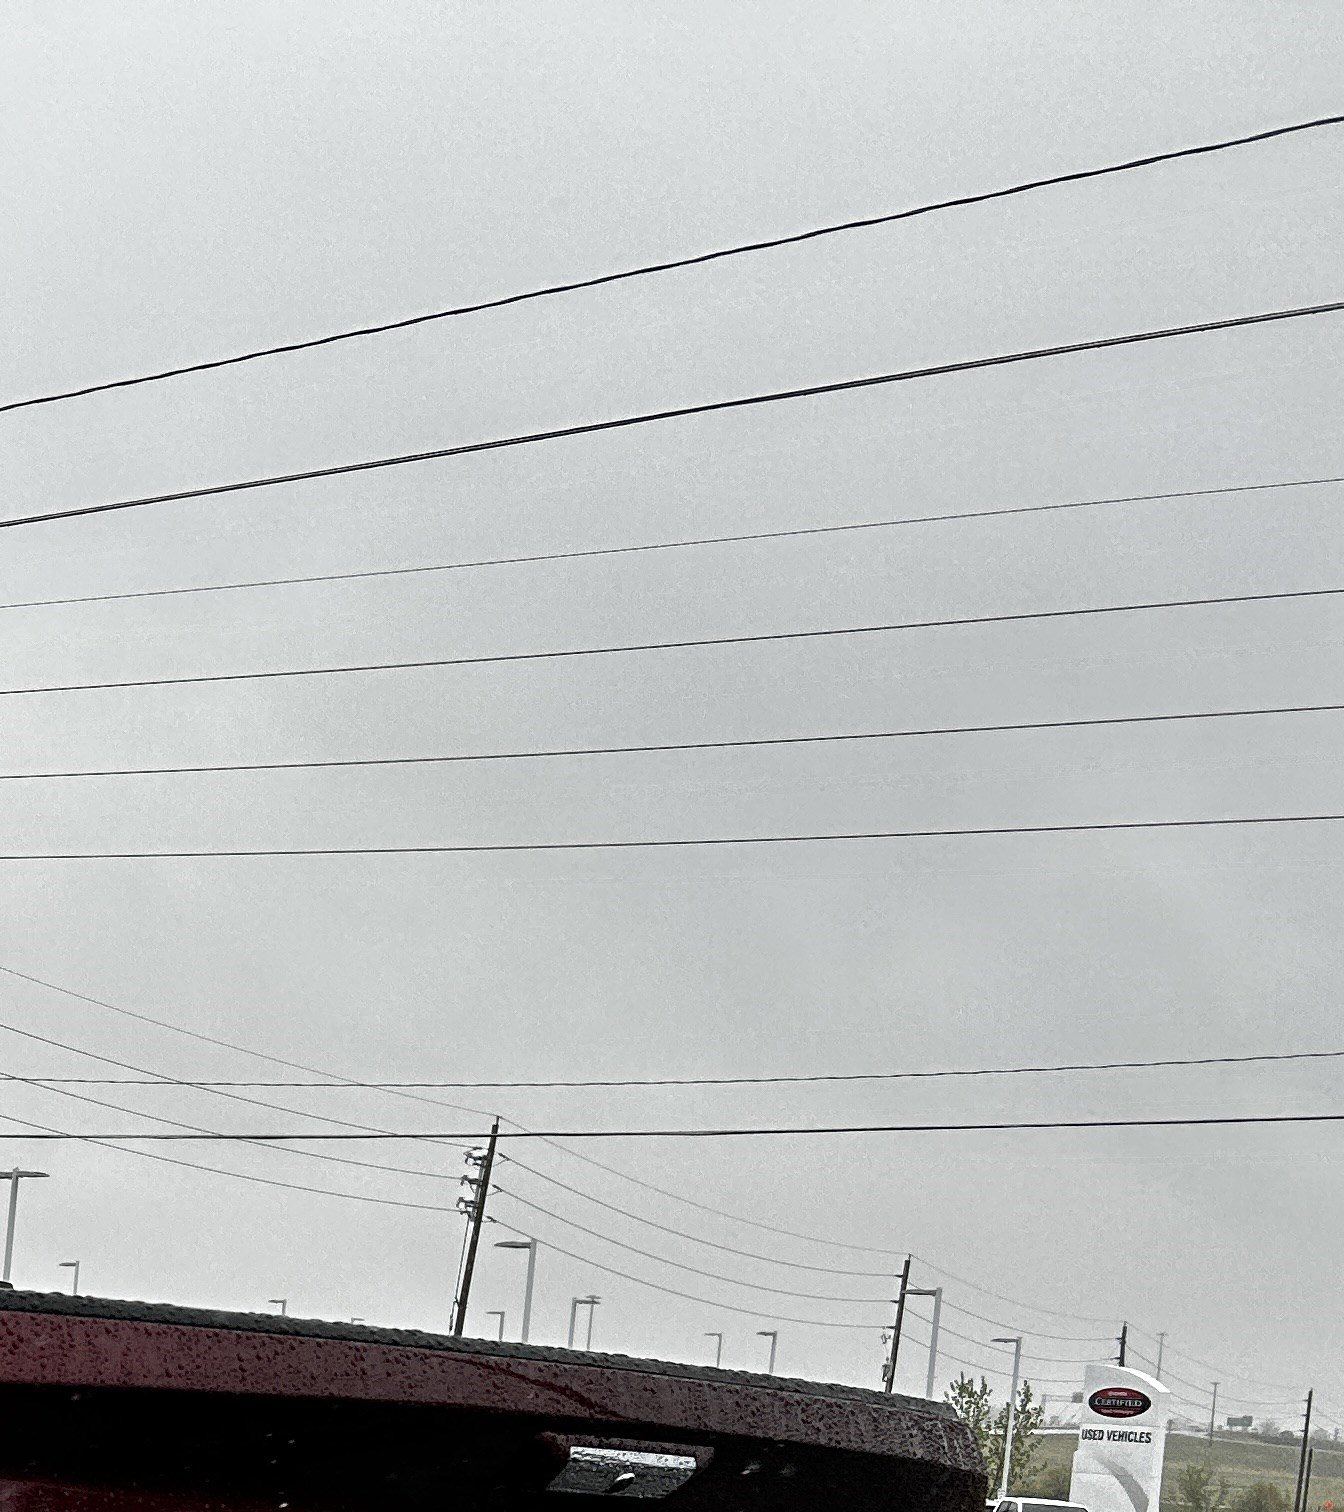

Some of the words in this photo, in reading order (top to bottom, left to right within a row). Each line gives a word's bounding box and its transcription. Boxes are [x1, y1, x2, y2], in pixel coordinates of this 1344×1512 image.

[1095, 1397, 1142, 1407] CERTIFIED
[1082, 1429, 1104, 1441] USED
[1107, 1430, 1152, 1443] VEHICLES
